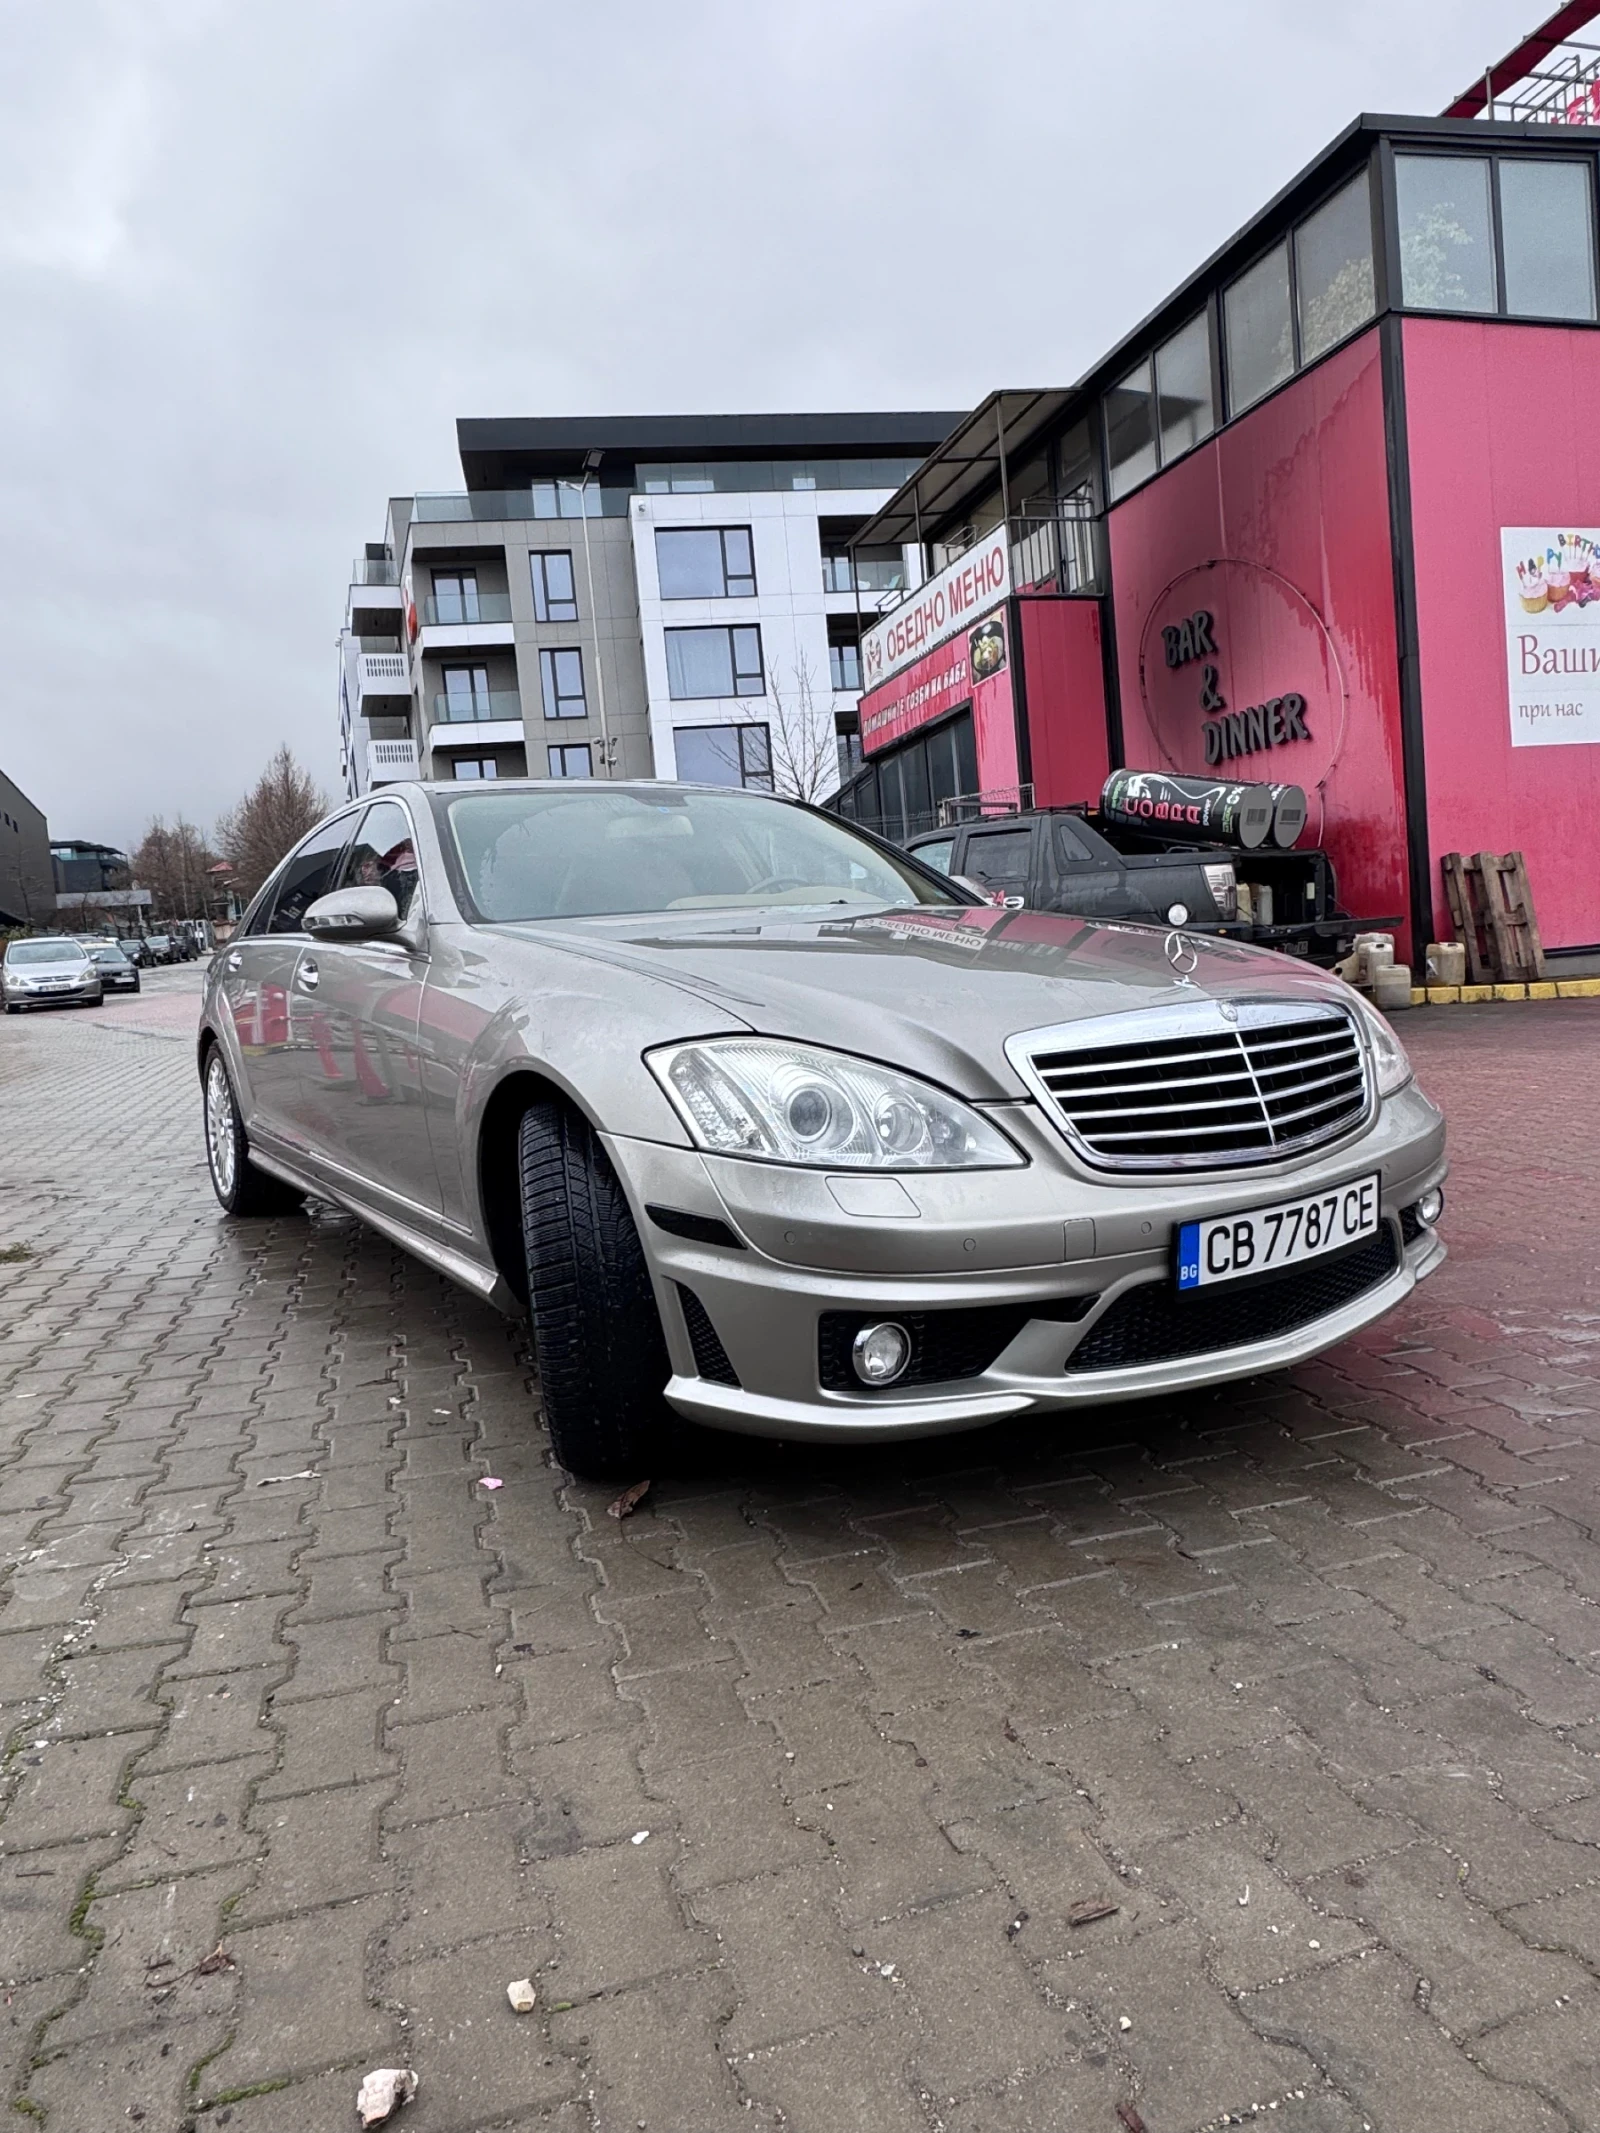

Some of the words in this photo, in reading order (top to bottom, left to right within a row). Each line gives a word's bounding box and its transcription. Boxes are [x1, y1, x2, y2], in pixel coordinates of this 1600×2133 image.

[1516, 547, 1562, 579] HAPPY
[886, 590, 945, 663] ОБЕДНО
[948, 546, 1005, 618] МЕНЮ
[1161, 610, 1216, 667] BAR
[930, 674, 942, 698] НА
[943, 657, 968, 690] БАБА
[1201, 665, 1225, 711] &
[1202, 692, 1310, 766] DINNER
[1519, 703, 1551, 725] при
[1555, 703, 1583, 717] нас
[1124, 797, 1202, 825] COBRA
[1207, 1220, 1255, 1274] CB
[1263, 1196, 1338, 1263] 7787
[1343, 1183, 1374, 1236] CE
[1180, 1263, 1198, 1281] BG
